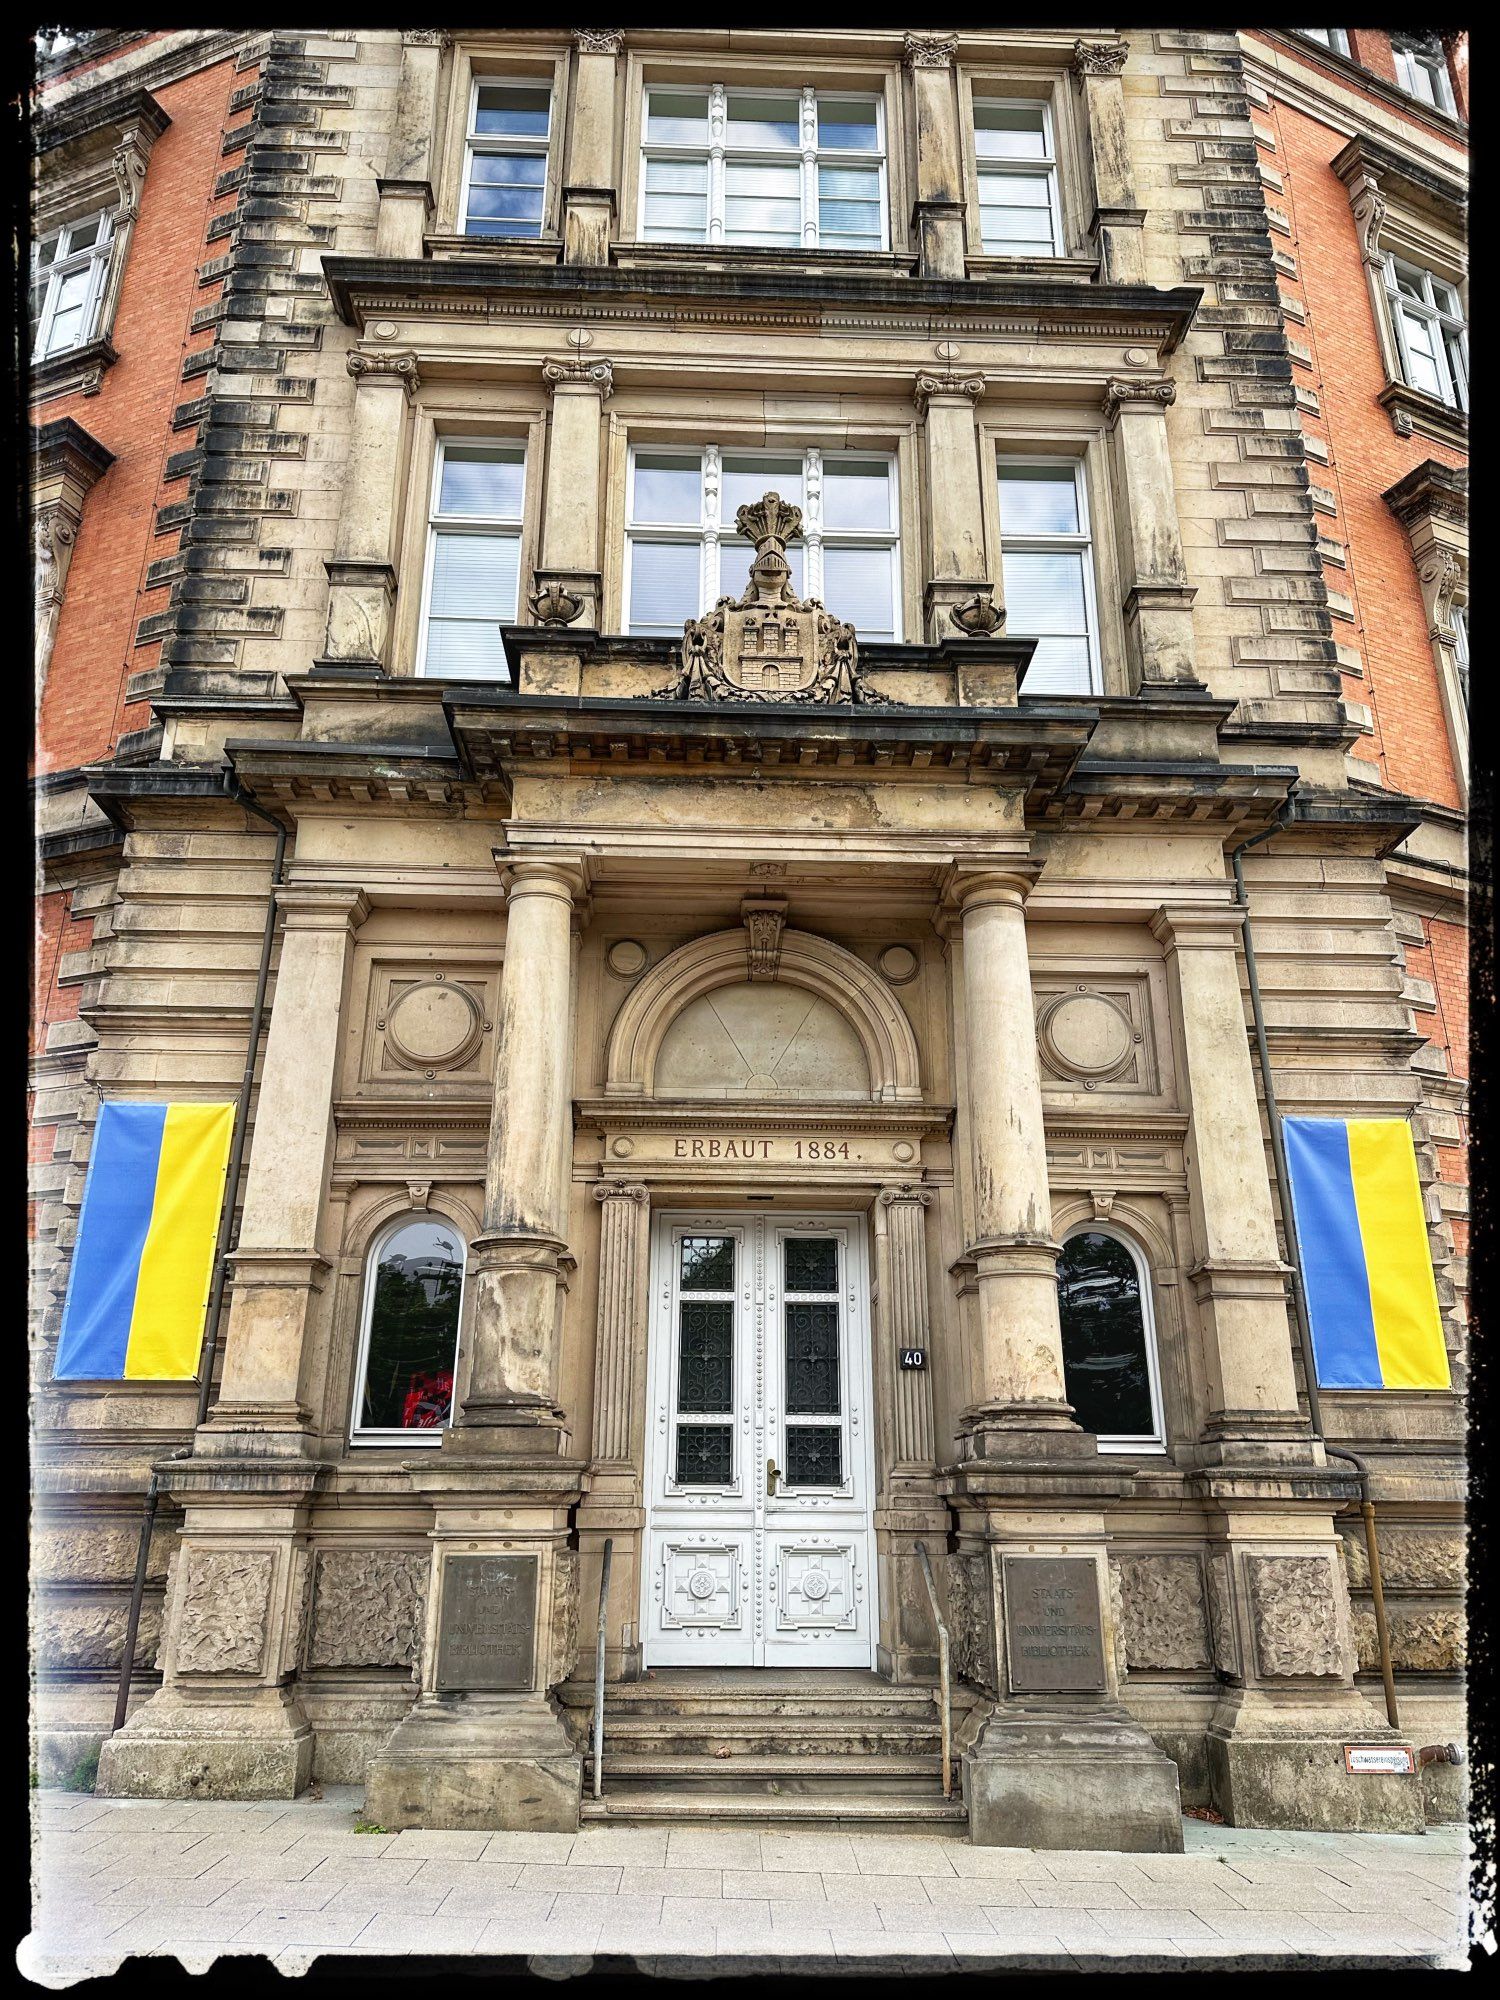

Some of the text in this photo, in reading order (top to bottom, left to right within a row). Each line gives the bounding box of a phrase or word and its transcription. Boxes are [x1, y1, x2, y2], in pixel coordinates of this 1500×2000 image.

[674, 1138, 774, 1159] ERBAUT
[904, 1351, 922, 1365] 40
[1043, 1607, 1065, 1616] UND
[449, 1643, 521, 1656] BIBLIOTHEK
[1021, 1645, 1090, 1657] BIBLIOTHEK
